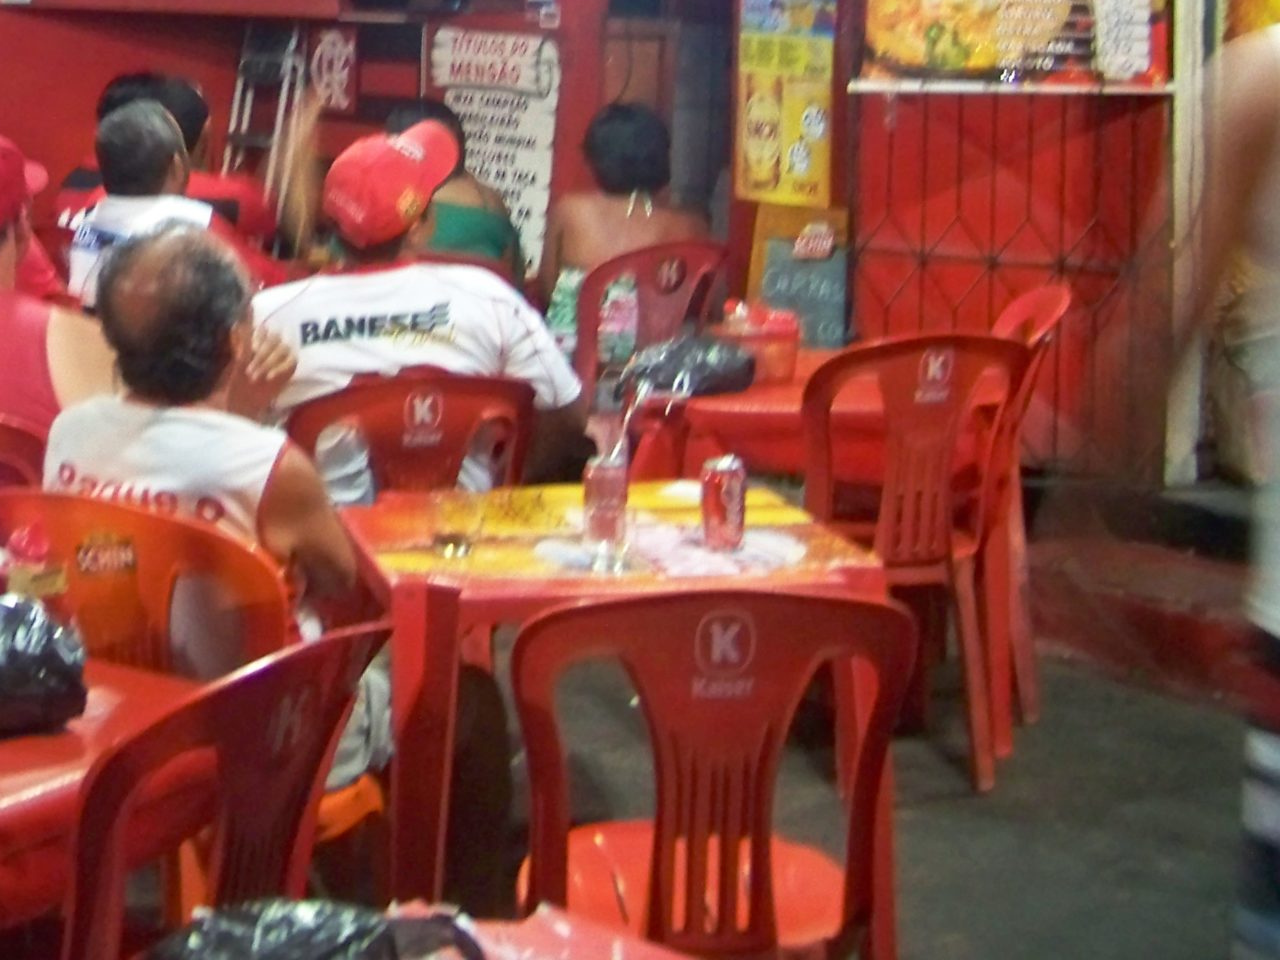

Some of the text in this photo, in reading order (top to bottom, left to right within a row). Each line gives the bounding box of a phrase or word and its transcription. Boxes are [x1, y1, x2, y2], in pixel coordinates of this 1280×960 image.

[300, 305, 445, 346] BANESE
[413, 393, 434, 425] K
[710, 621, 742, 663] K
